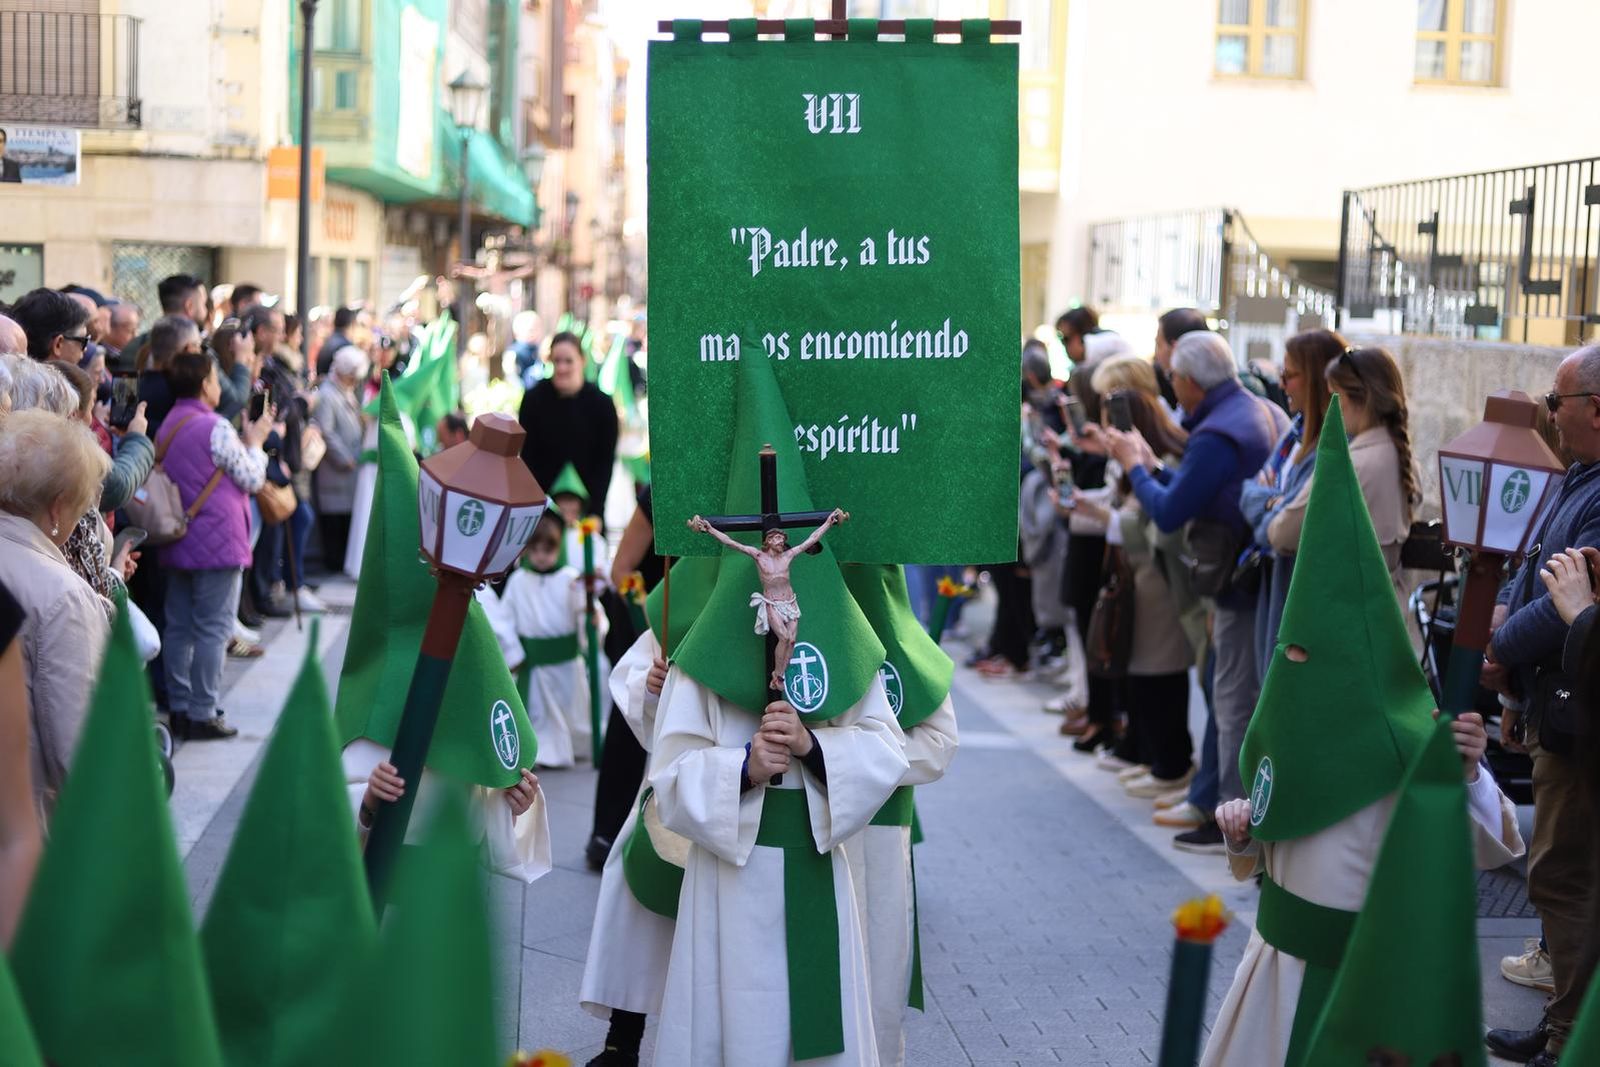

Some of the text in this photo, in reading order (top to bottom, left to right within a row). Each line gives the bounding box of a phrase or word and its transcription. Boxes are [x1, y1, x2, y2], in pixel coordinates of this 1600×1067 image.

[802, 93, 862, 134] VII
[730, 226, 930, 278] "Padre, a tus
[700, 317, 969, 361] maos encomiendo
[793, 413, 917, 461] espíritu"
[1443, 466, 1482, 506] VII
